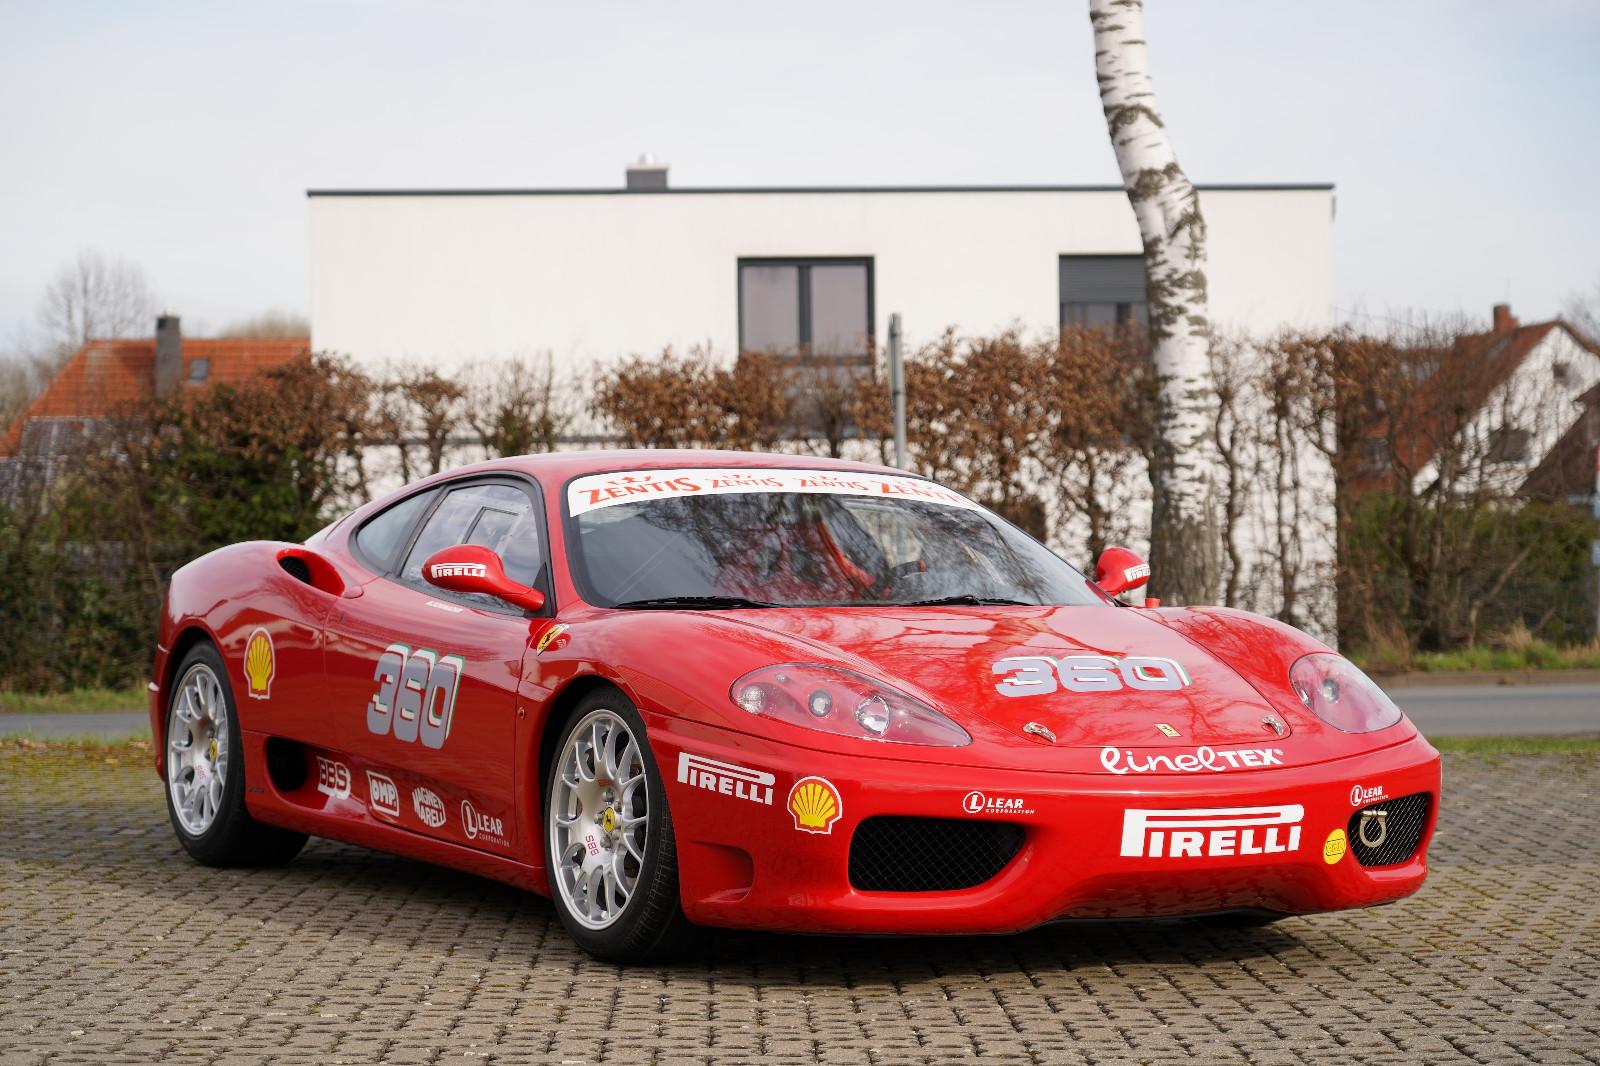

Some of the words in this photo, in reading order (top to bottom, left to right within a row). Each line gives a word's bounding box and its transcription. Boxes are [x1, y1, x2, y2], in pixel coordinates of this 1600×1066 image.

[578, 477, 702, 505] ZENTIS
[704, 477, 784, 489] ZENTIS
[793, 477, 869, 491] ZENTIS
[430, 562, 487, 579] PIRELLI
[991, 655, 1192, 698] 360
[366, 642, 465, 750] 360
[317, 757, 351, 798] BBS
[676, 751, 776, 806] PIRELLI
[1363, 785, 1383, 799] LEAR
[986, 797, 1024, 809] LEAR
[477, 812, 504, 837] LEAR
[1119, 803, 1305, 858] PIRELLI
